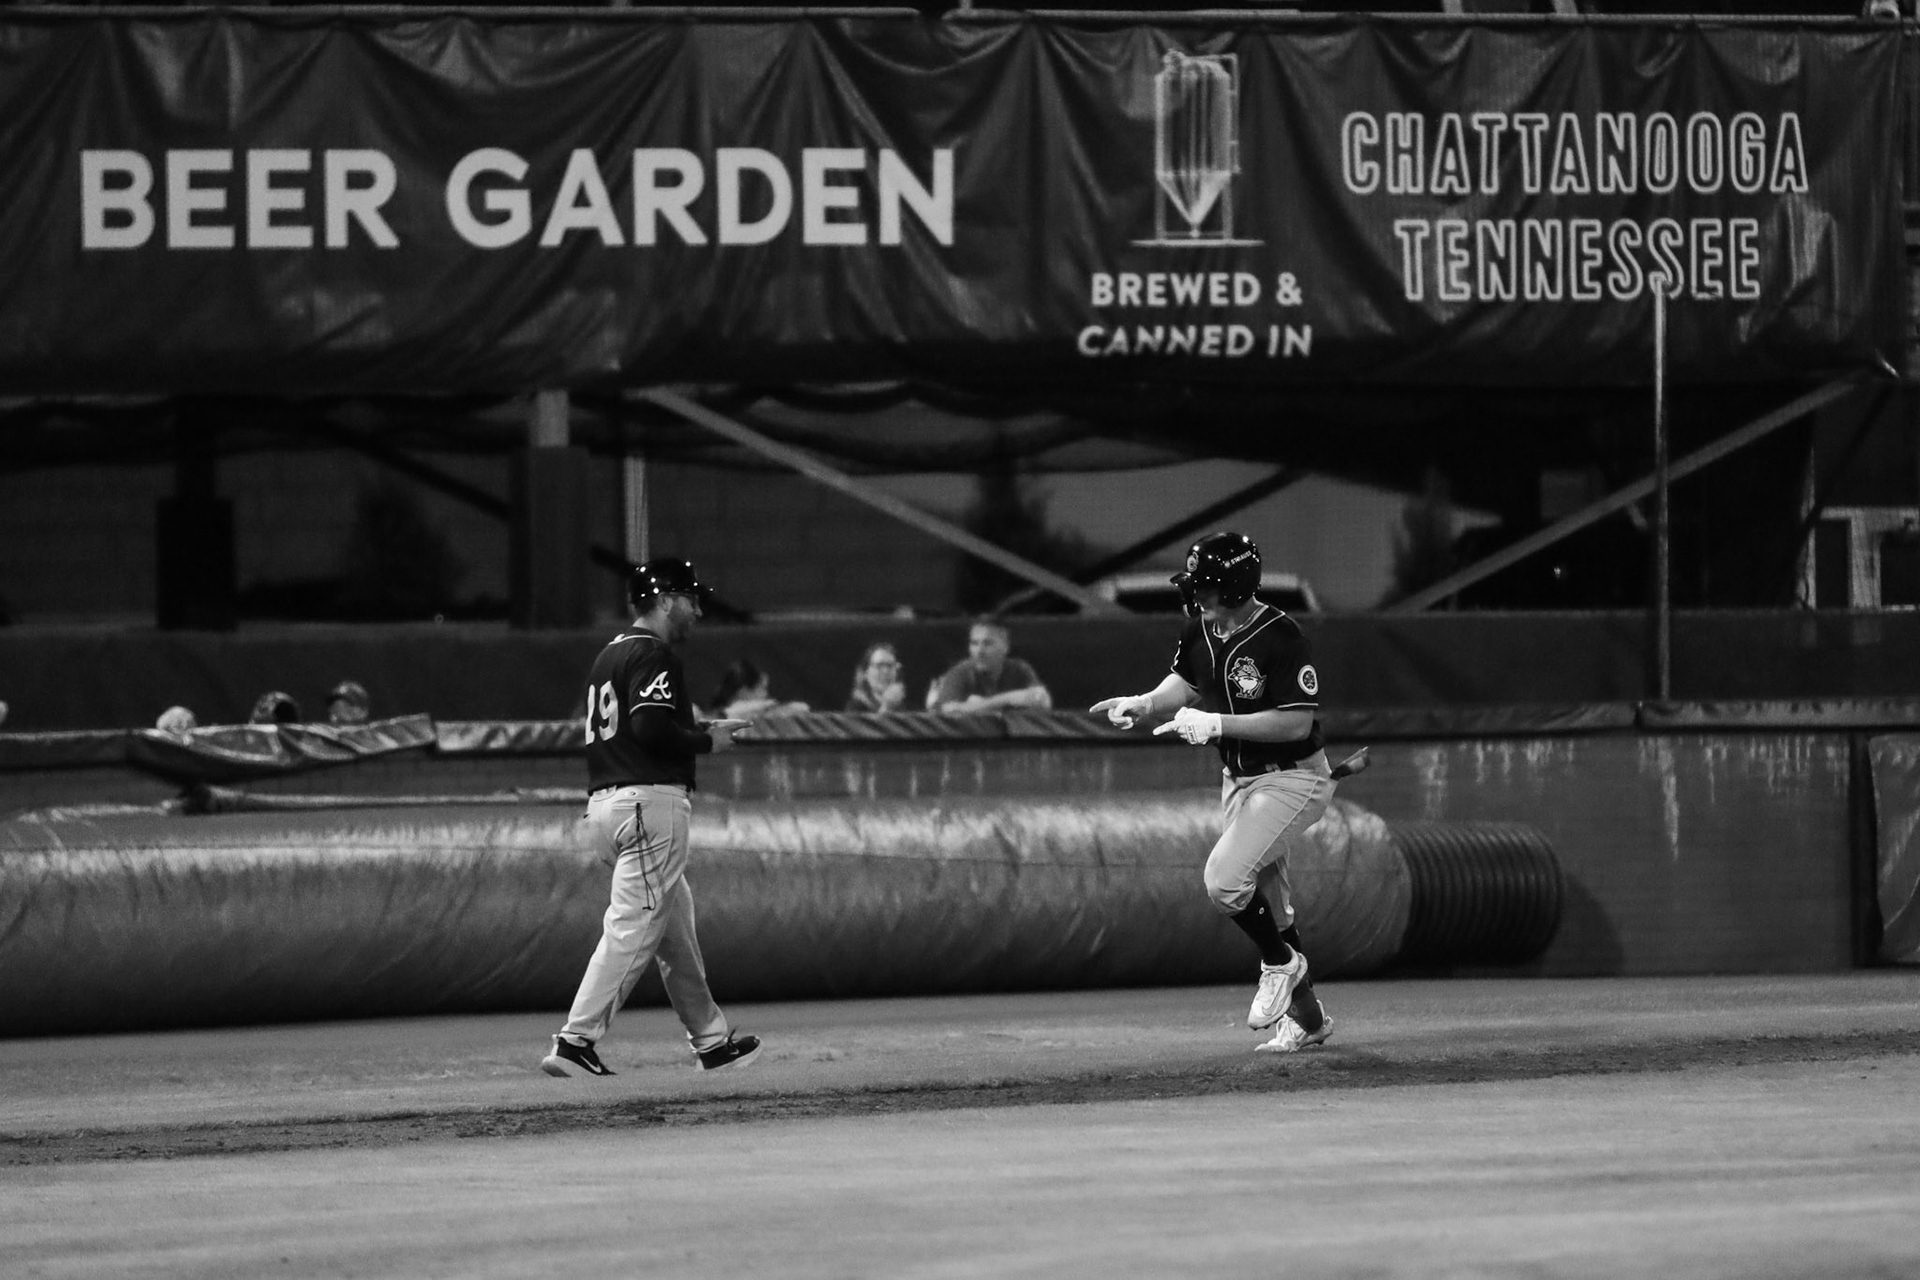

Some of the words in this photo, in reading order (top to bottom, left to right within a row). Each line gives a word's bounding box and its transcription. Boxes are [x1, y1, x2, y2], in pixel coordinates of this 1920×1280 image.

[1341, 111, 1809, 195] CHATTANOOGA
[80, 148, 400, 250] BEER
[445, 147, 955, 248] GARDEN
[1090, 272, 1261, 307] BREWED
[1275, 272, 1304, 306] &
[1394, 217, 1761, 302] TENNESSEE
[1077, 324, 1255, 357] CANNED
[1267, 324, 1313, 357] IN
[584, 680, 619, 746] 19
[639, 670, 672, 700] A
